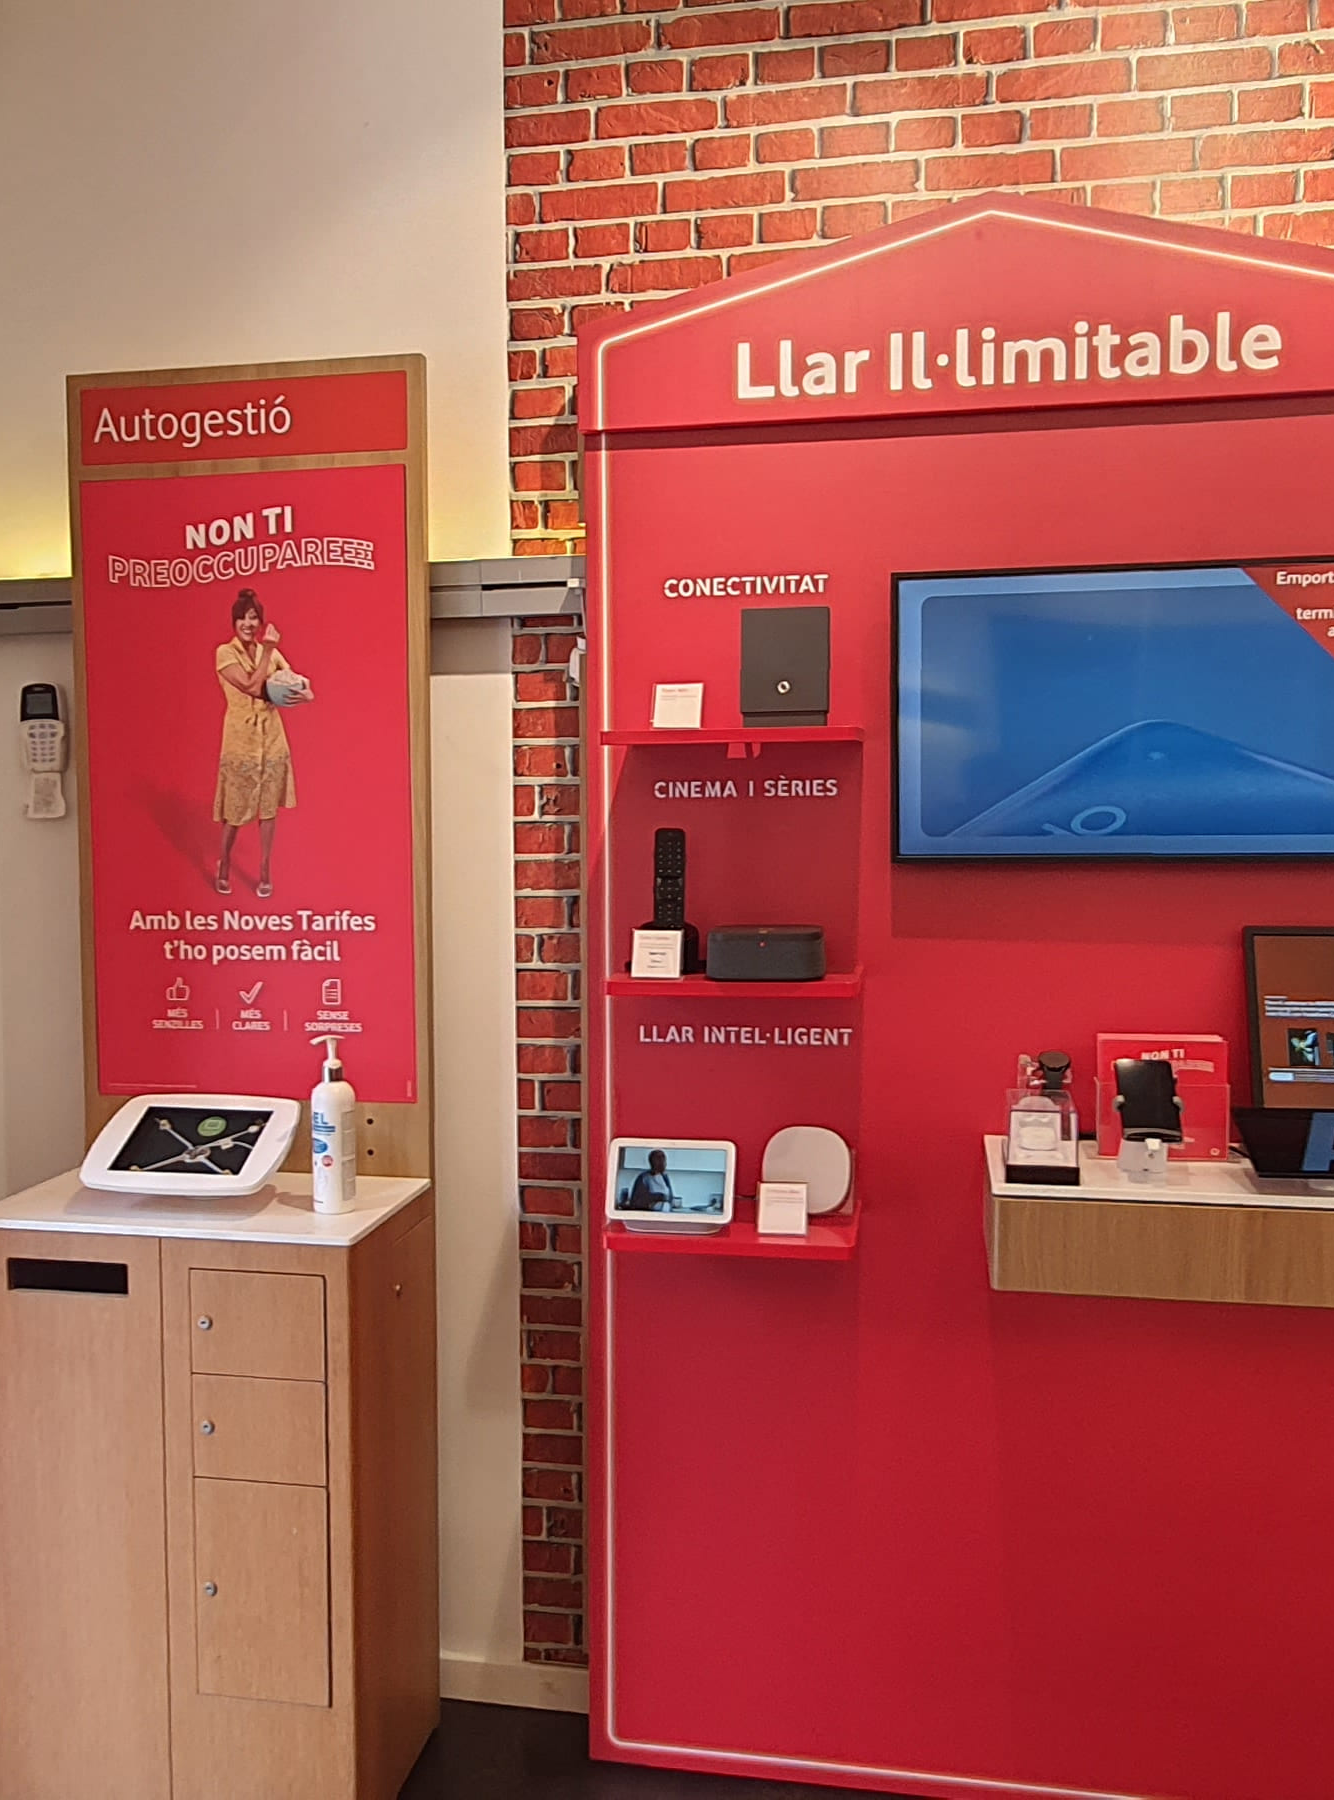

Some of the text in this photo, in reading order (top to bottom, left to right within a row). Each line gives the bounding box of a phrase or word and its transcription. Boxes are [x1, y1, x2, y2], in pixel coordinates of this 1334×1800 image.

[737, 339, 870, 399] Llar
[94, 395, 291, 448] Autogestió
[185, 505, 292, 550] NON TI
[664, 574, 829, 598] CONECTIVITAT
[654, 775, 838, 799] CINEMA I SÈRIES
[129, 910, 376, 931] Amb les Noves Tarifes
[163, 939, 341, 965] t'ho posem fàcil
[166, 1007, 188, 1018] MÉS
[240, 1008, 262, 1019] MÉS
[316, 1010, 350, 1020] SENSE
[639, 1025, 695, 1043] LLAR
[1171, 1048, 1185, 1059] TI
